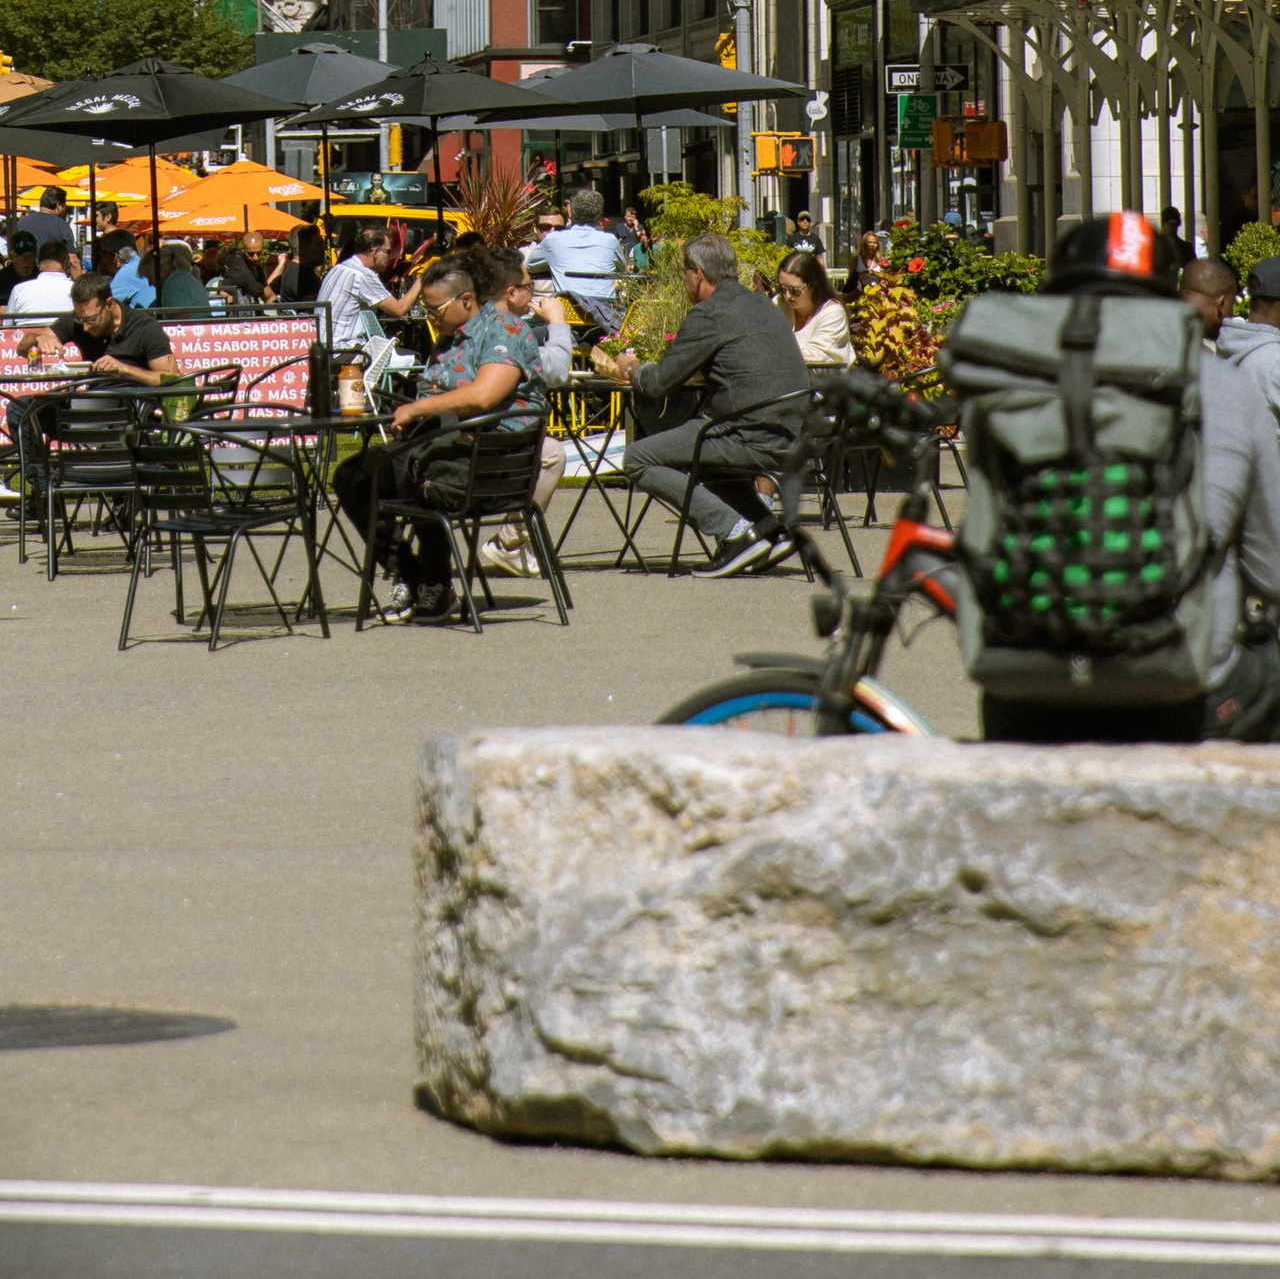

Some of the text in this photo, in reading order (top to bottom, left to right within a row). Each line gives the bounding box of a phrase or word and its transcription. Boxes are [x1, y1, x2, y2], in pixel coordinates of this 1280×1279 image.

[243, 323, 289, 335] SABOR
[181, 338, 318, 353] MÁS SABOR POR FAV
[184, 357, 230, 369] SABOR
[233, 356, 260, 368] POR
[22, 381, 49, 392] POR
[268, 387, 297, 401] MÁS
